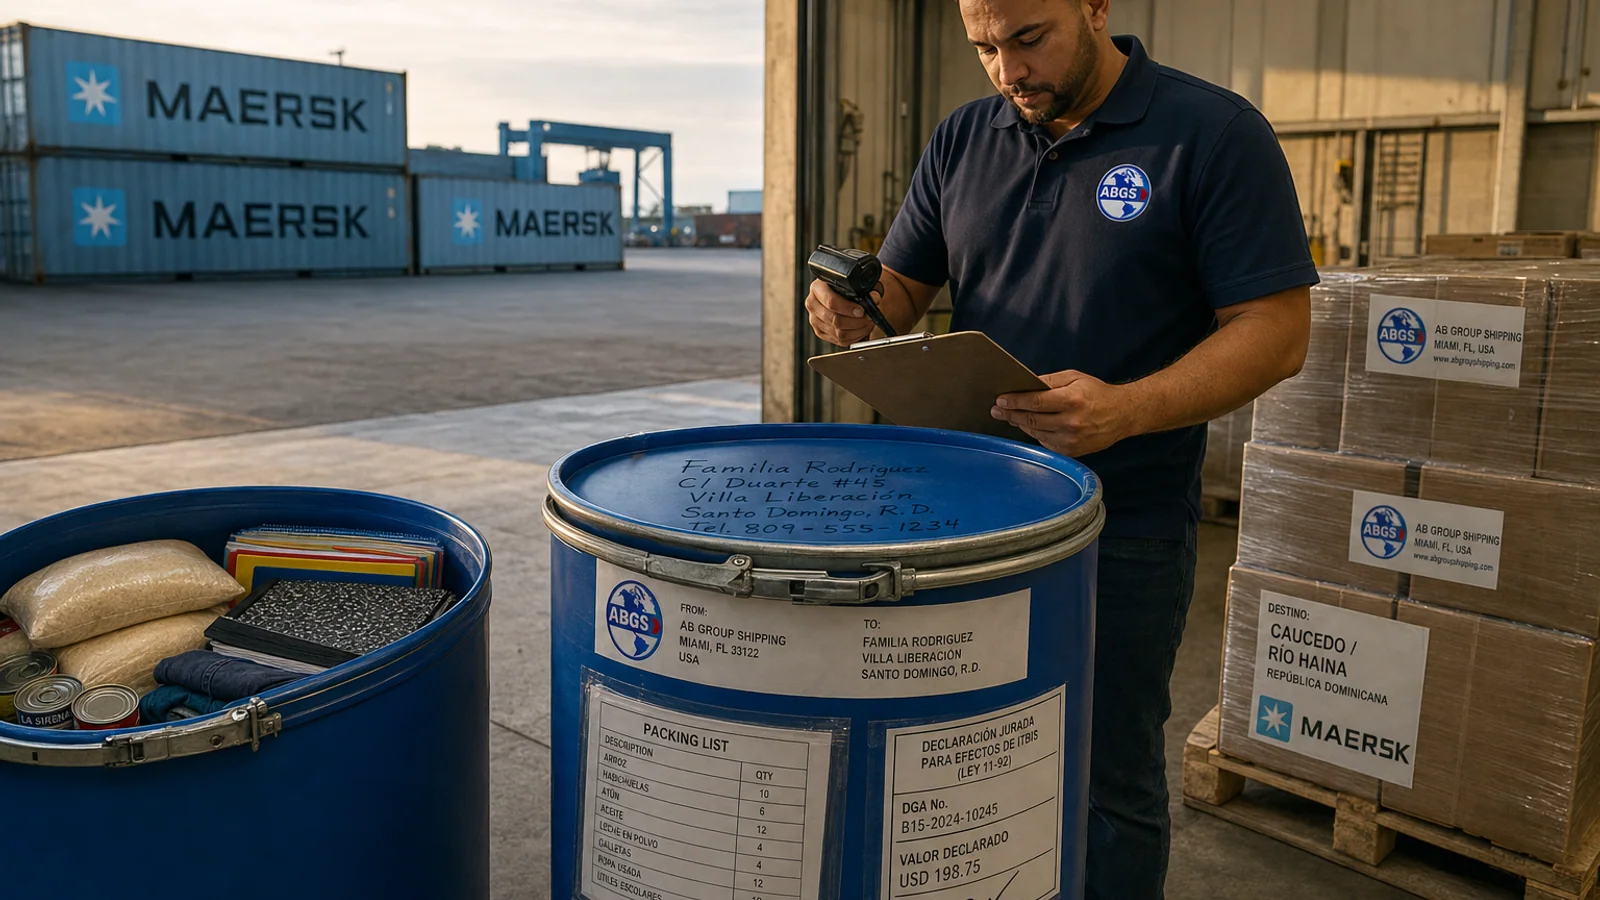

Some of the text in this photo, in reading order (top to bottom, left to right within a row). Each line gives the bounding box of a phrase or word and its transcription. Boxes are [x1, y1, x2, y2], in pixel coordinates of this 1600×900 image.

[147, 80, 367, 133] MAERSK
[1100, 186, 1138, 199] ABGS
[154, 201, 370, 239] MAERSK
[496, 208, 614, 238] MAERSK
[1379, 327, 1415, 342] ABGS
[1435, 325, 1522, 343] AB GROUP SHIPPING
[1478, 345, 1495, 355] USA
[682, 459, 930, 478] Familia Rodriguez
[678, 477, 887, 489] C/ Duarte #45
[689, 488, 912, 503] Villa Liberación
[681, 506, 757, 519] Santo
[767, 505, 872, 522] Domingo,
[687, 522, 730, 535] Tel.
[1363, 523, 1397, 539] ABGS
[1415, 523, 1500, 546] AB GROUP SHIPPING
[1455, 544, 1472, 556] USA
[680, 603, 708, 617] FROM:
[1268, 602, 1310, 621] DESTINO:
[608, 606, 650, 632] ABGS
[863, 619, 881, 630] TO:
[680, 620, 787, 646] AB GROUP SHIPPING
[863, 631, 973, 648] FAMILIA RODRIGUEZ
[1270, 623, 1358, 656] CAUCEDO /
[679, 636, 759, 659] MIAMI, FL 33122
[862, 648, 962, 664] VILLA LIBERACIÓN
[679, 652, 700, 665] USA
[1268, 644, 1348, 678] RÍO HAINA
[861, 668, 900, 680] SANTO
[903, 665, 958, 680] DOMINGO,
[1266, 667, 1388, 706] REPÚBLICA DOMINICANA
[20, 714, 33, 725] LA
[643, 722, 729, 753] PACKING LIST
[921, 715, 1035, 753] DECLARACIÓN JURADA
[1300, 715, 1411, 765] MAERSK
[921, 729, 1039, 770] PARA EFECTOS DE ITBIS
[756, 770, 774, 781] QTY
[957, 754, 1012, 781] (LEY 11-92)
[760, 789, 769, 799] 10
[759, 806, 765, 816] 6
[902, 798, 949, 815] DGA No.
[901, 802, 999, 834] B15-2024-10245
[757, 825, 767, 835] 12
[633, 833, 659, 849] POLVO
[757, 843, 763, 852] 4
[900, 830, 1009, 866] VALOR DECLARADO
[756, 860, 762, 870] 4
[900, 859, 981, 888] USD 198.75
[753, 878, 764, 889] 12
